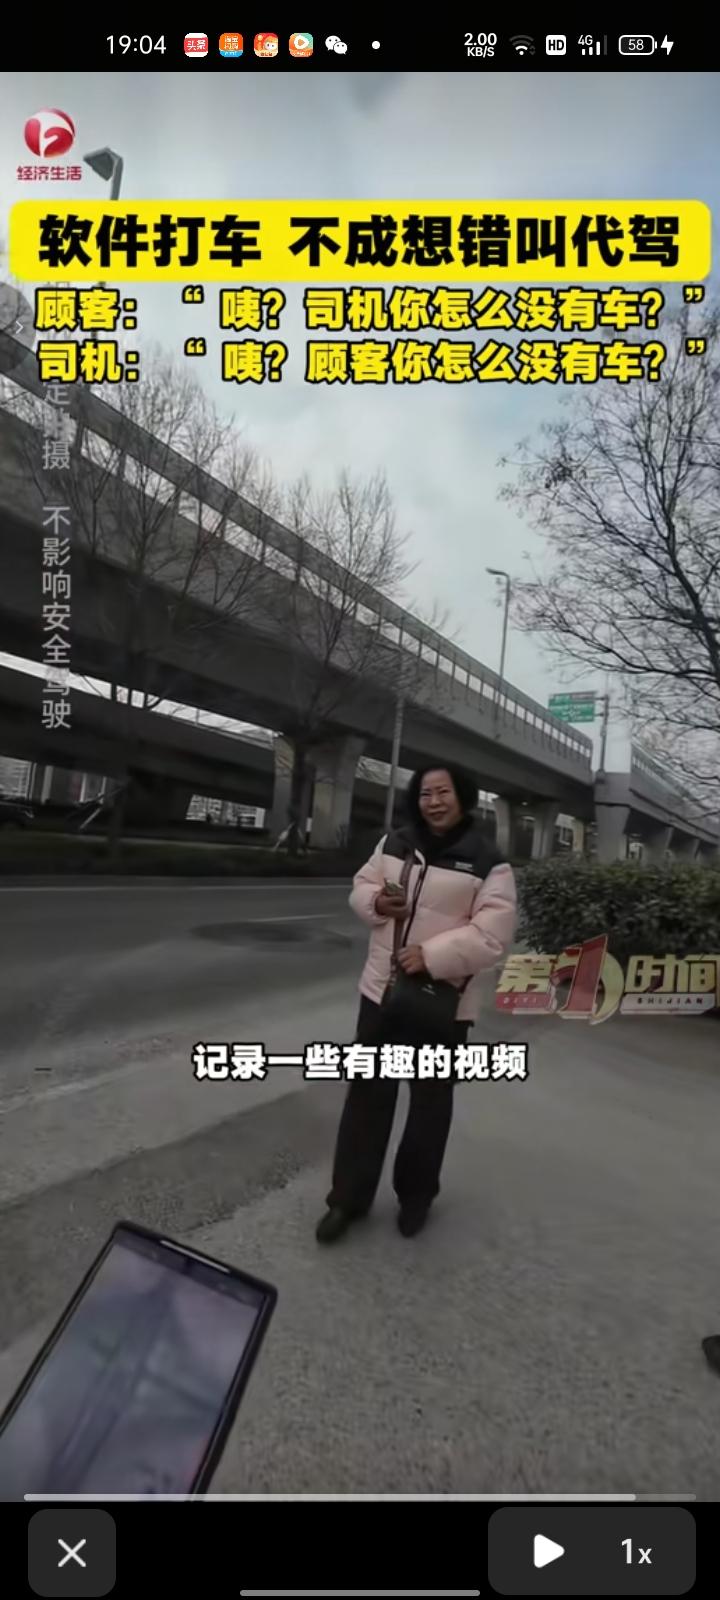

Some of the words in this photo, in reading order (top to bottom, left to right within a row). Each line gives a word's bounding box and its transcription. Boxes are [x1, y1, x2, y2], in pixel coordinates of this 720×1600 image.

[107, 35, 166, 54] 19:04
[464, 33, 498, 46] 2.00
[547, 39, 565, 51] HD
[577, 34, 594, 47] 4G
[627, 38, 645, 51] 58
[467, 46, 495, 58] KB/S
[621, 1538, 652, 1564] 1x
